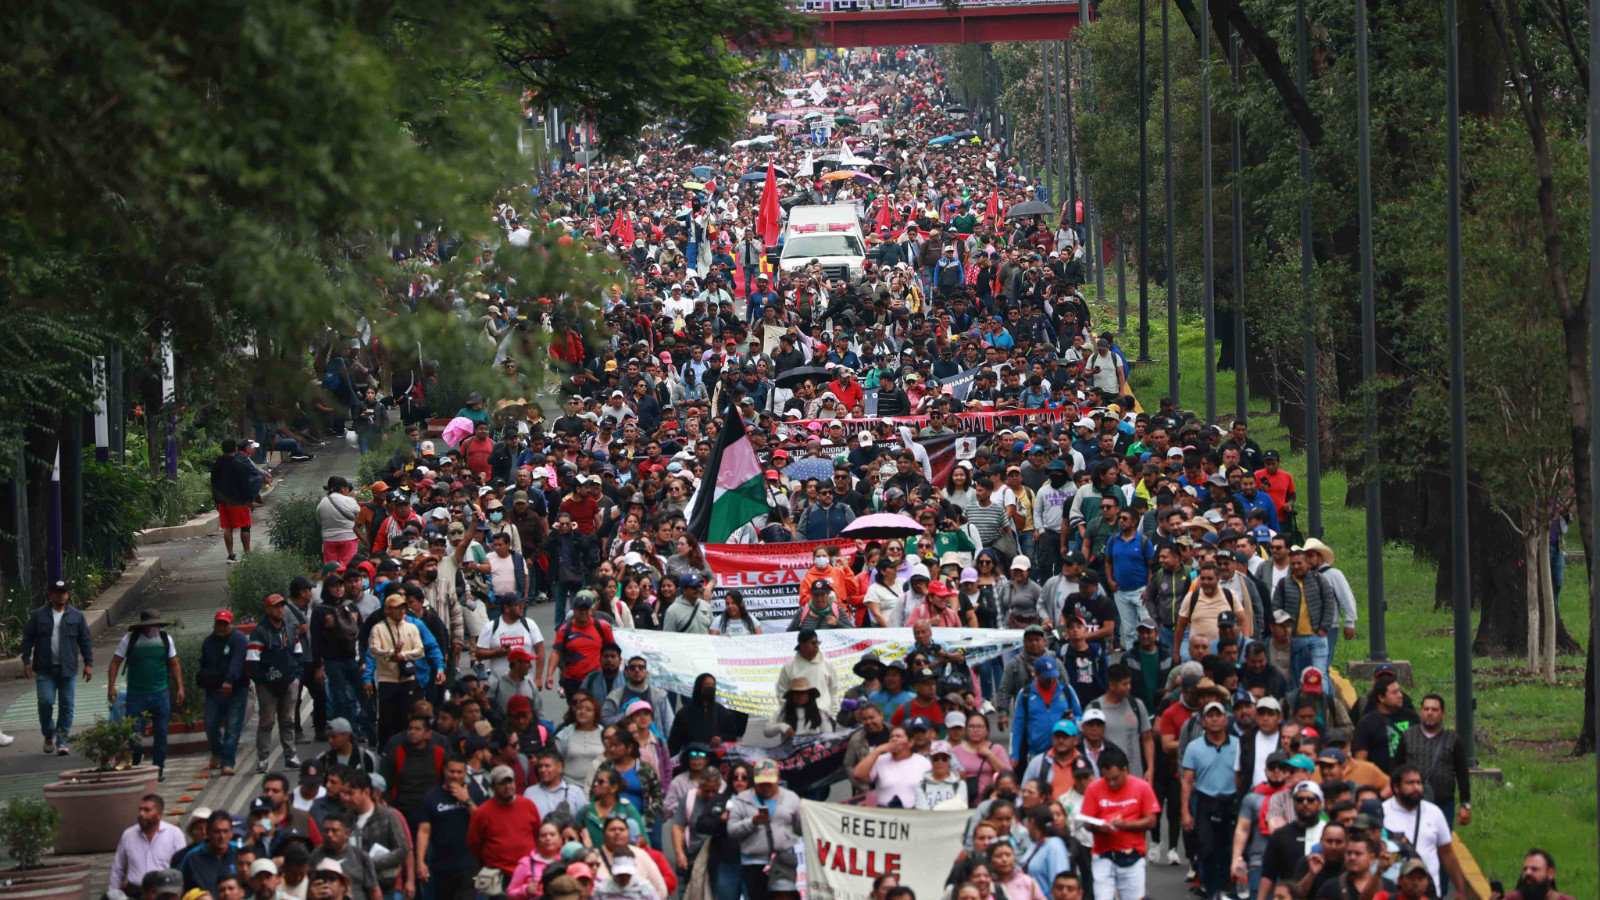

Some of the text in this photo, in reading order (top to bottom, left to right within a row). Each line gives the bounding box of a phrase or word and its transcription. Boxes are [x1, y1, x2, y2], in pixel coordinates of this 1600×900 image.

[715, 570, 800, 587] ELGA
[772, 587, 785, 595] DE
[787, 586, 799, 595] LA
[841, 816, 911, 841] REGIÓN
[816, 837, 902, 881] VALLE
